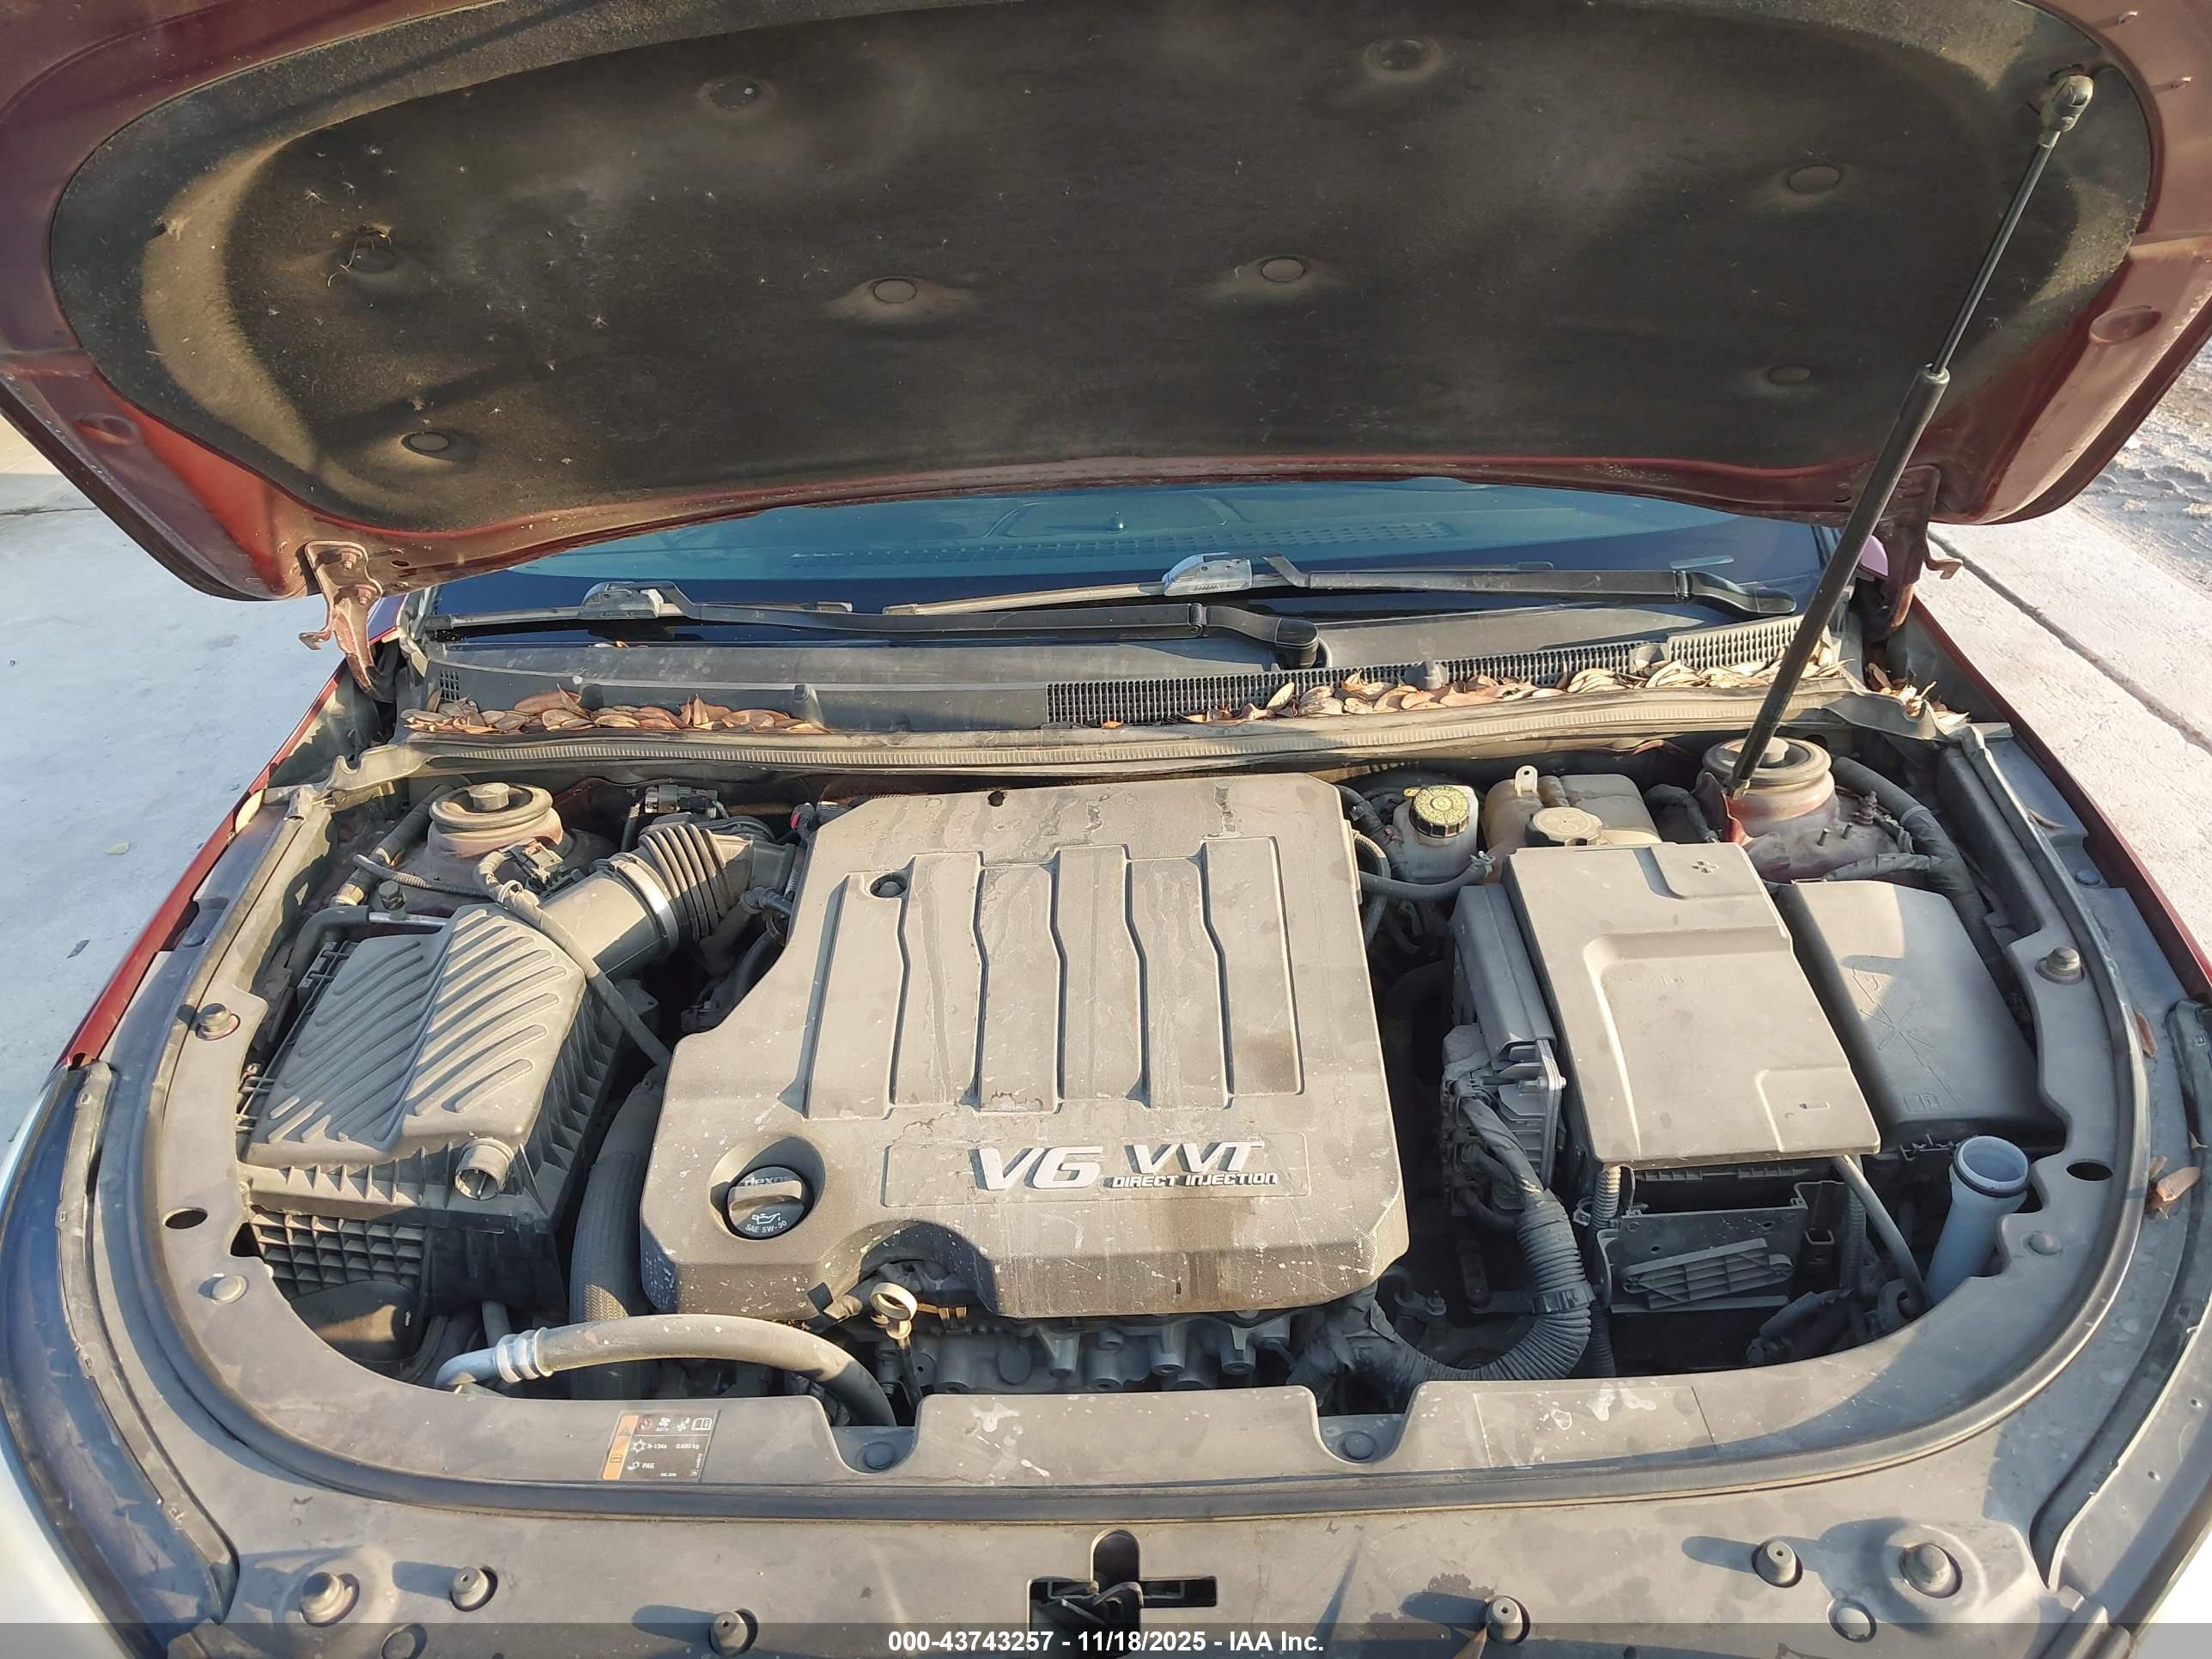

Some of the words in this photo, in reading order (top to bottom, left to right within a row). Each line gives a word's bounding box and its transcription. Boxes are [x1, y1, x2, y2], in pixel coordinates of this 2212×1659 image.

[974, 1145, 1103, 1191] V6
[1127, 1141, 1266, 1175] VVT
[1112, 1175, 1179, 1188] DIRECT
[1185, 1172, 1279, 1187] INJECTION
[744, 1224, 759, 1233] SAE
[762, 1220, 787, 1233] 5W-30
